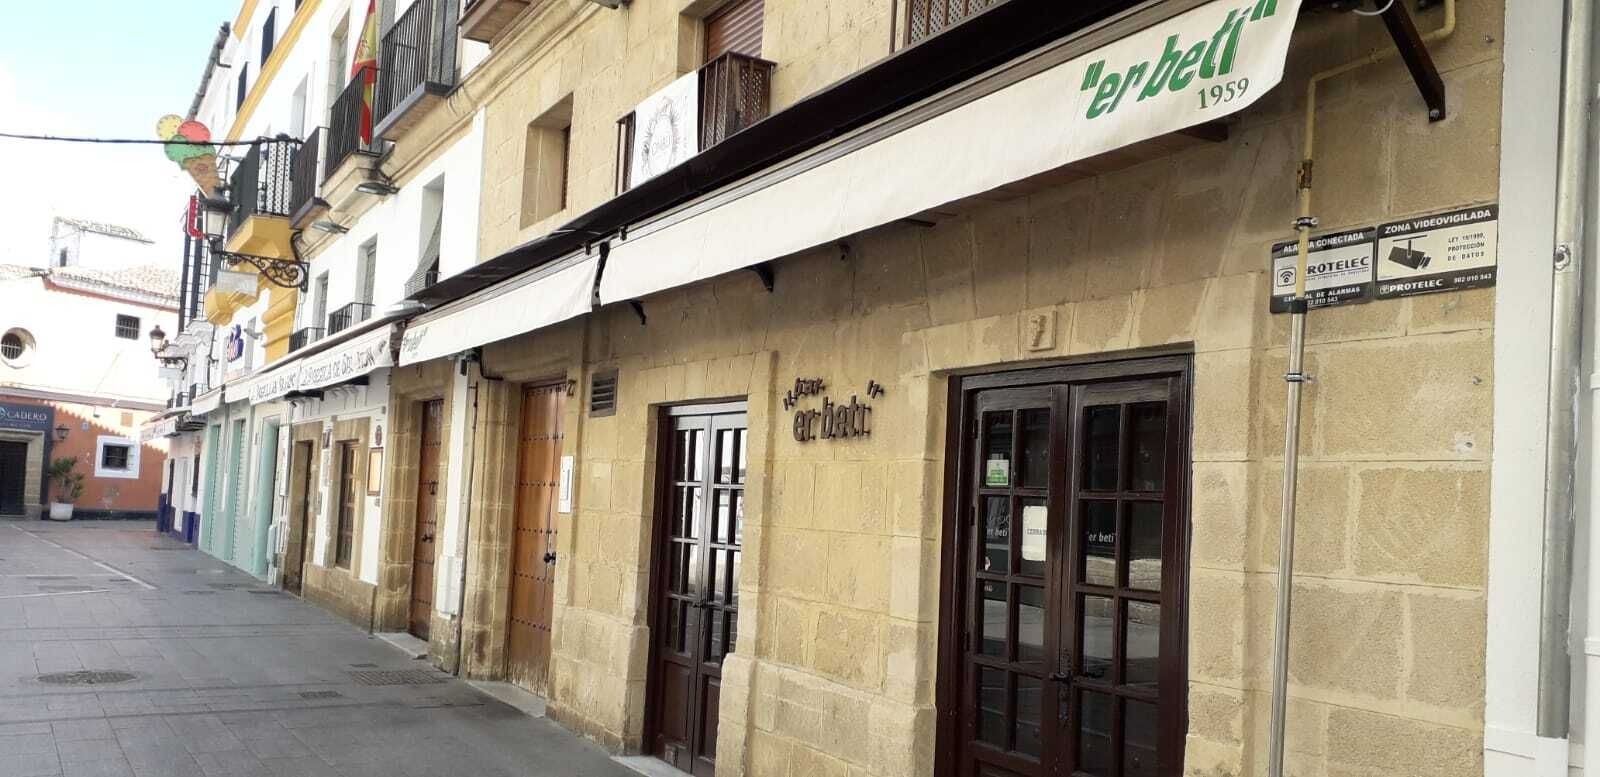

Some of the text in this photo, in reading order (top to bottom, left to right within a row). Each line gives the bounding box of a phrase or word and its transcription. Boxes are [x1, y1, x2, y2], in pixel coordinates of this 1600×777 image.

[1198, 77, 1250, 110] 1959
[1385, 208, 1492, 234] ZONA VIDEOVIGILADA
[1283, 231, 1365, 253] ALAA CONECTADA
[1306, 255, 1369, 275] ROTELEC
[1389, 278, 1445, 293] PROTELEC
